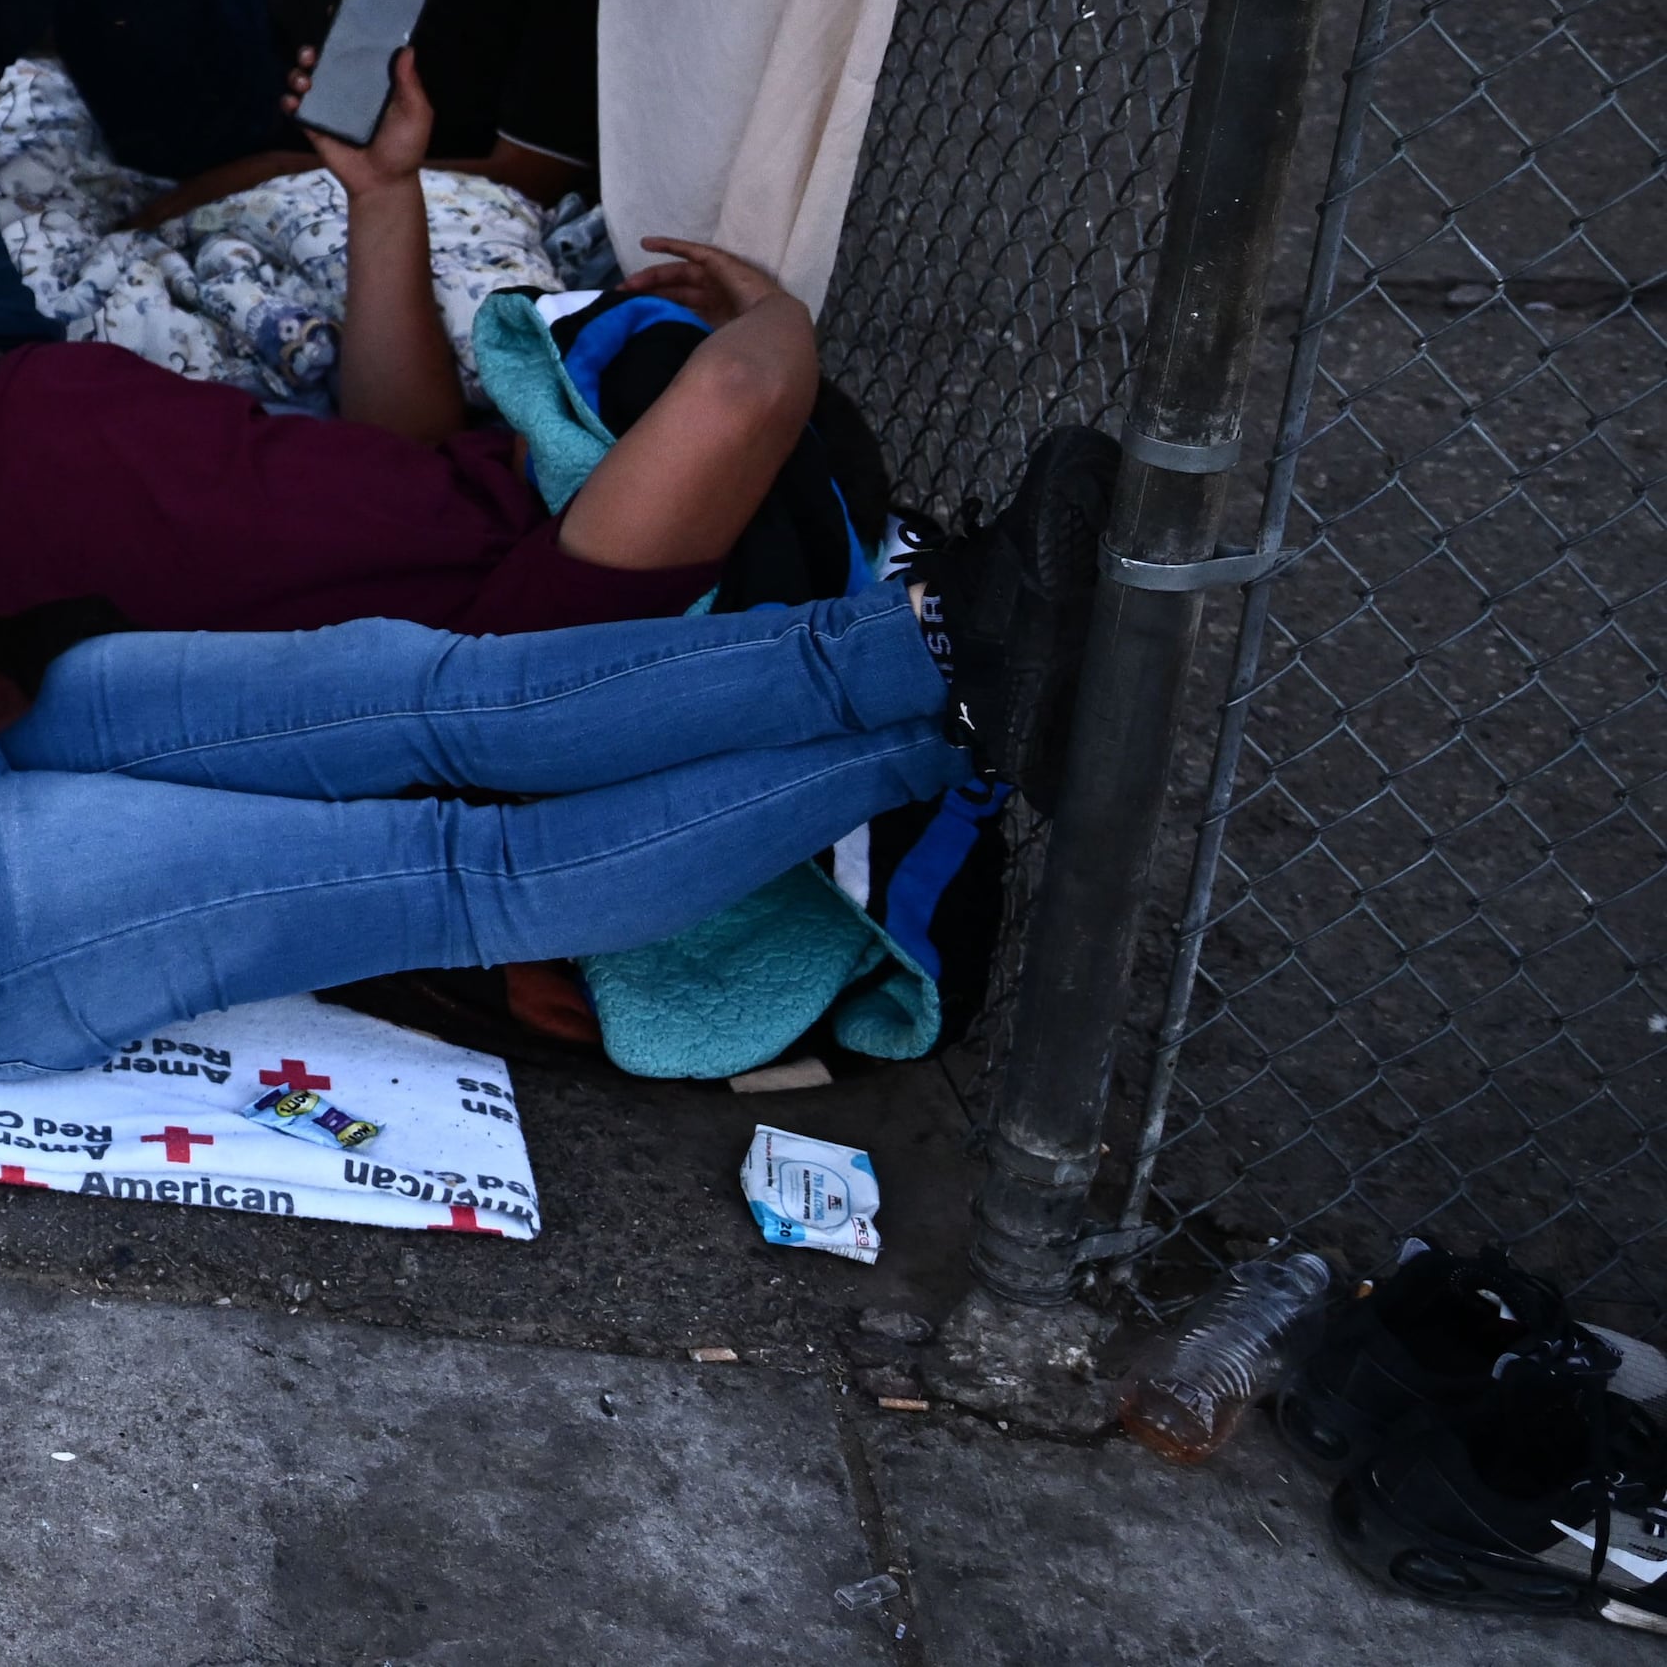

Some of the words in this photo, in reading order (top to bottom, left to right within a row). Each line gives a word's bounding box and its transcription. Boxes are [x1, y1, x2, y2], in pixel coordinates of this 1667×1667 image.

[33, 1117, 113, 1143] Red
[78, 1172, 295, 1214] American
[779, 1222, 792, 1238] 20
